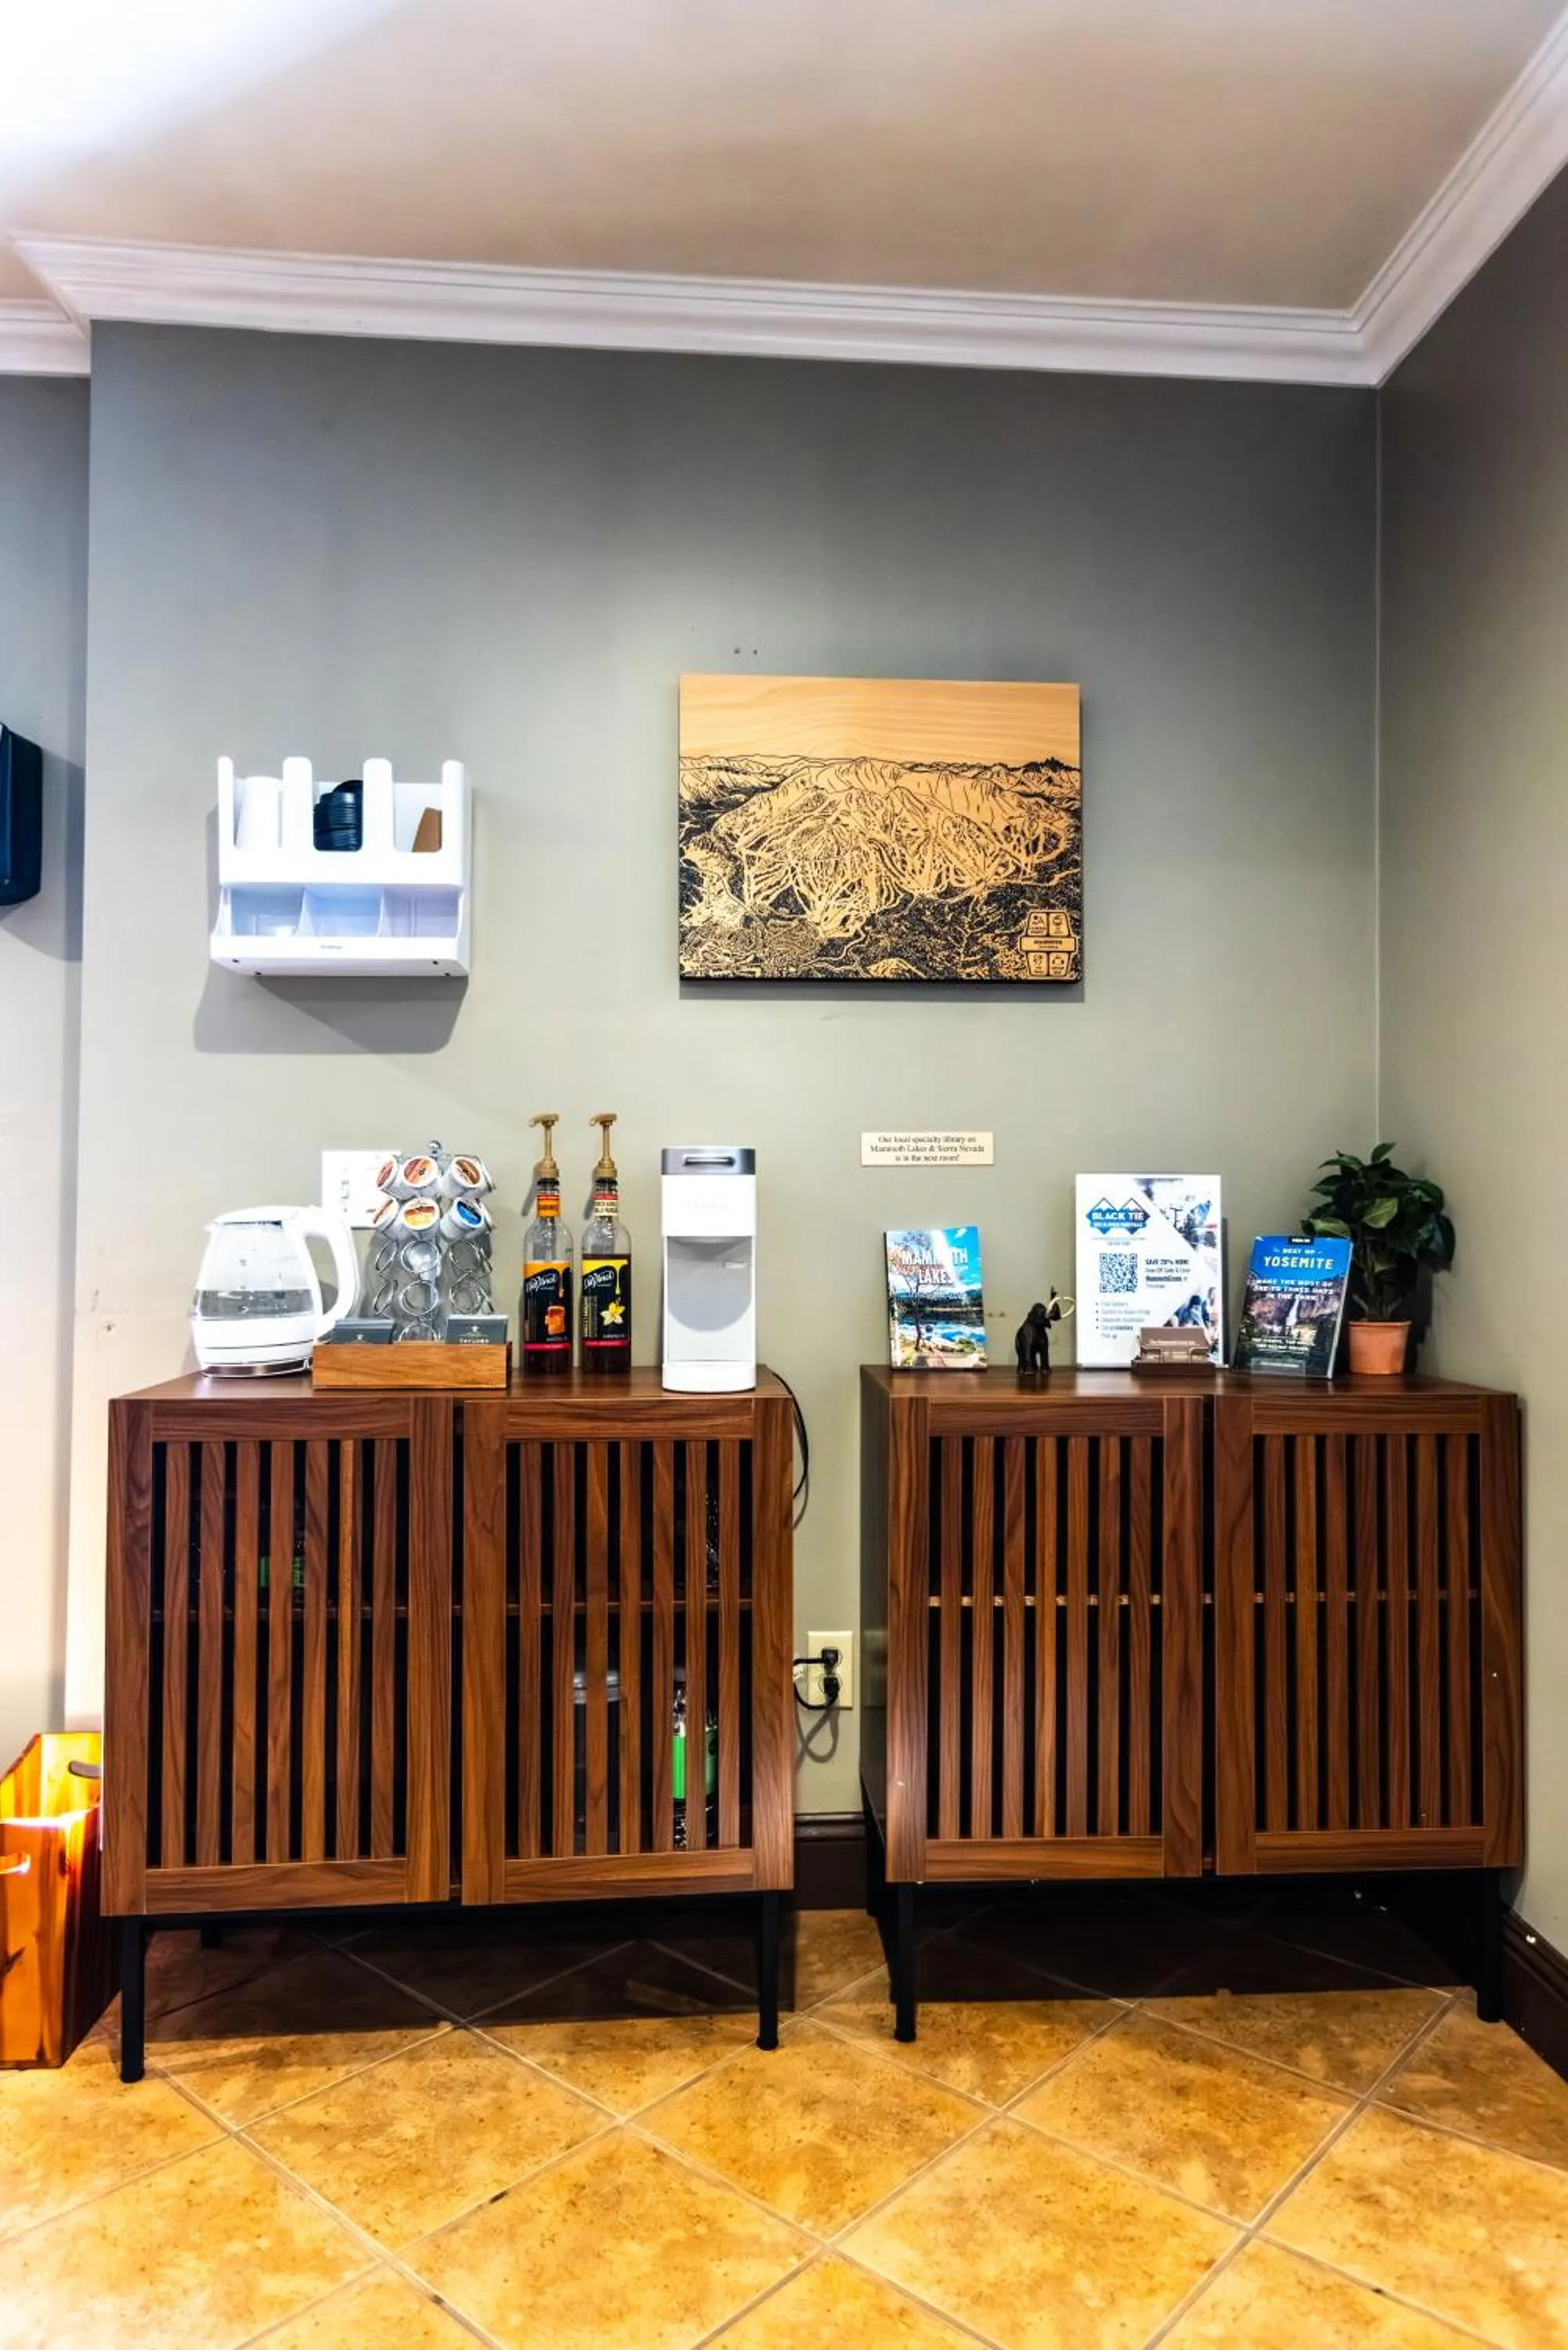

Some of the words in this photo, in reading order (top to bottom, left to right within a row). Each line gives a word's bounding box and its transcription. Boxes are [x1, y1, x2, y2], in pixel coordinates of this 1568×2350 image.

[912, 1135, 941, 1144] specialty
[943, 1135, 965, 1144] library
[1092, 1212, 1125, 1220] BLACK
[1128, 1212, 1144, 1221] TIE
[1263, 1255, 1335, 1270] YOSEMITE
[919, 1268, 953, 1284] LAKES
